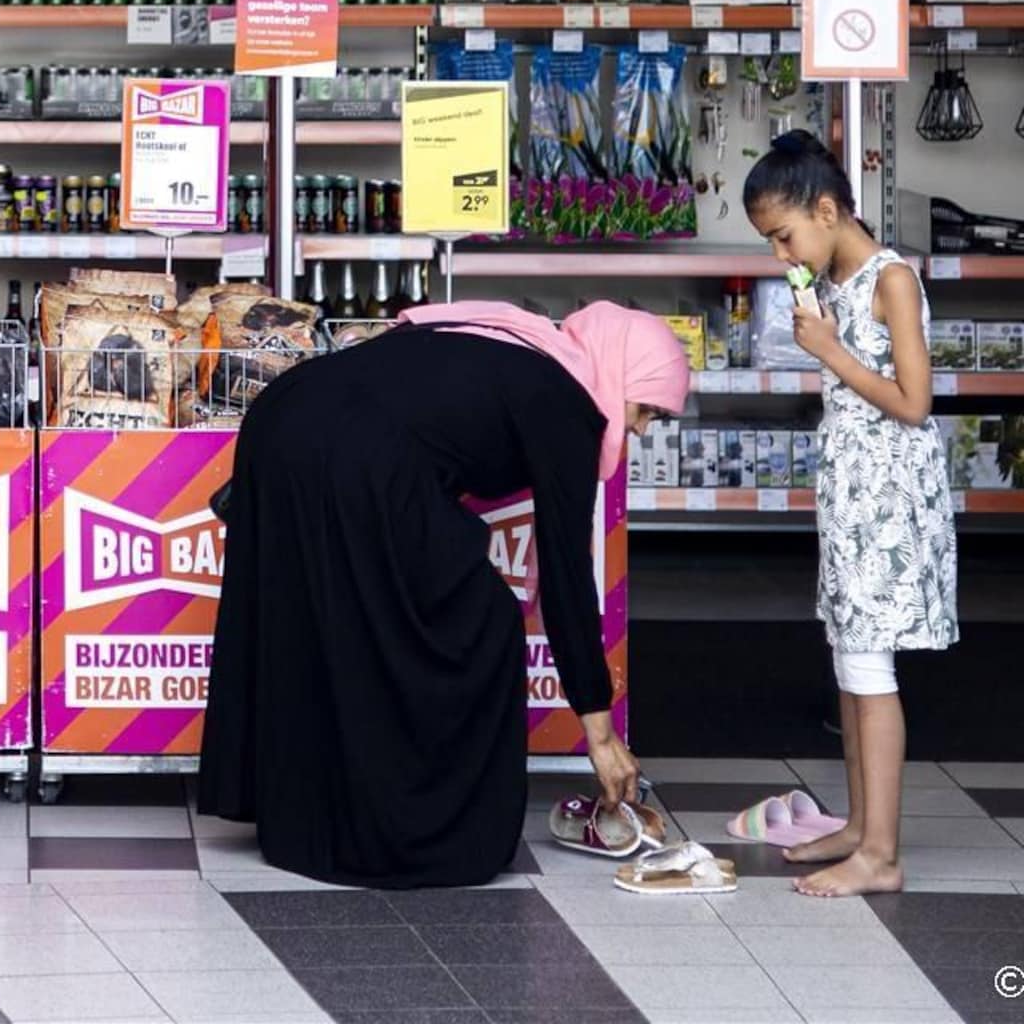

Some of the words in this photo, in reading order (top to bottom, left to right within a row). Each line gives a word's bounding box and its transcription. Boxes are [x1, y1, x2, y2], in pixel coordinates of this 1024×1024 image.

[247, 1, 297, 13] gezellige
[299, 2, 329, 12] team
[247, 14, 311, 25] versterken?
[140, 94, 158, 114] BIG
[161, 92, 197, 117] BAZAR
[461, 195, 489, 212] 2.99
[92, 524, 154, 581] BIG
[76, 675, 152, 701] BIZAR
